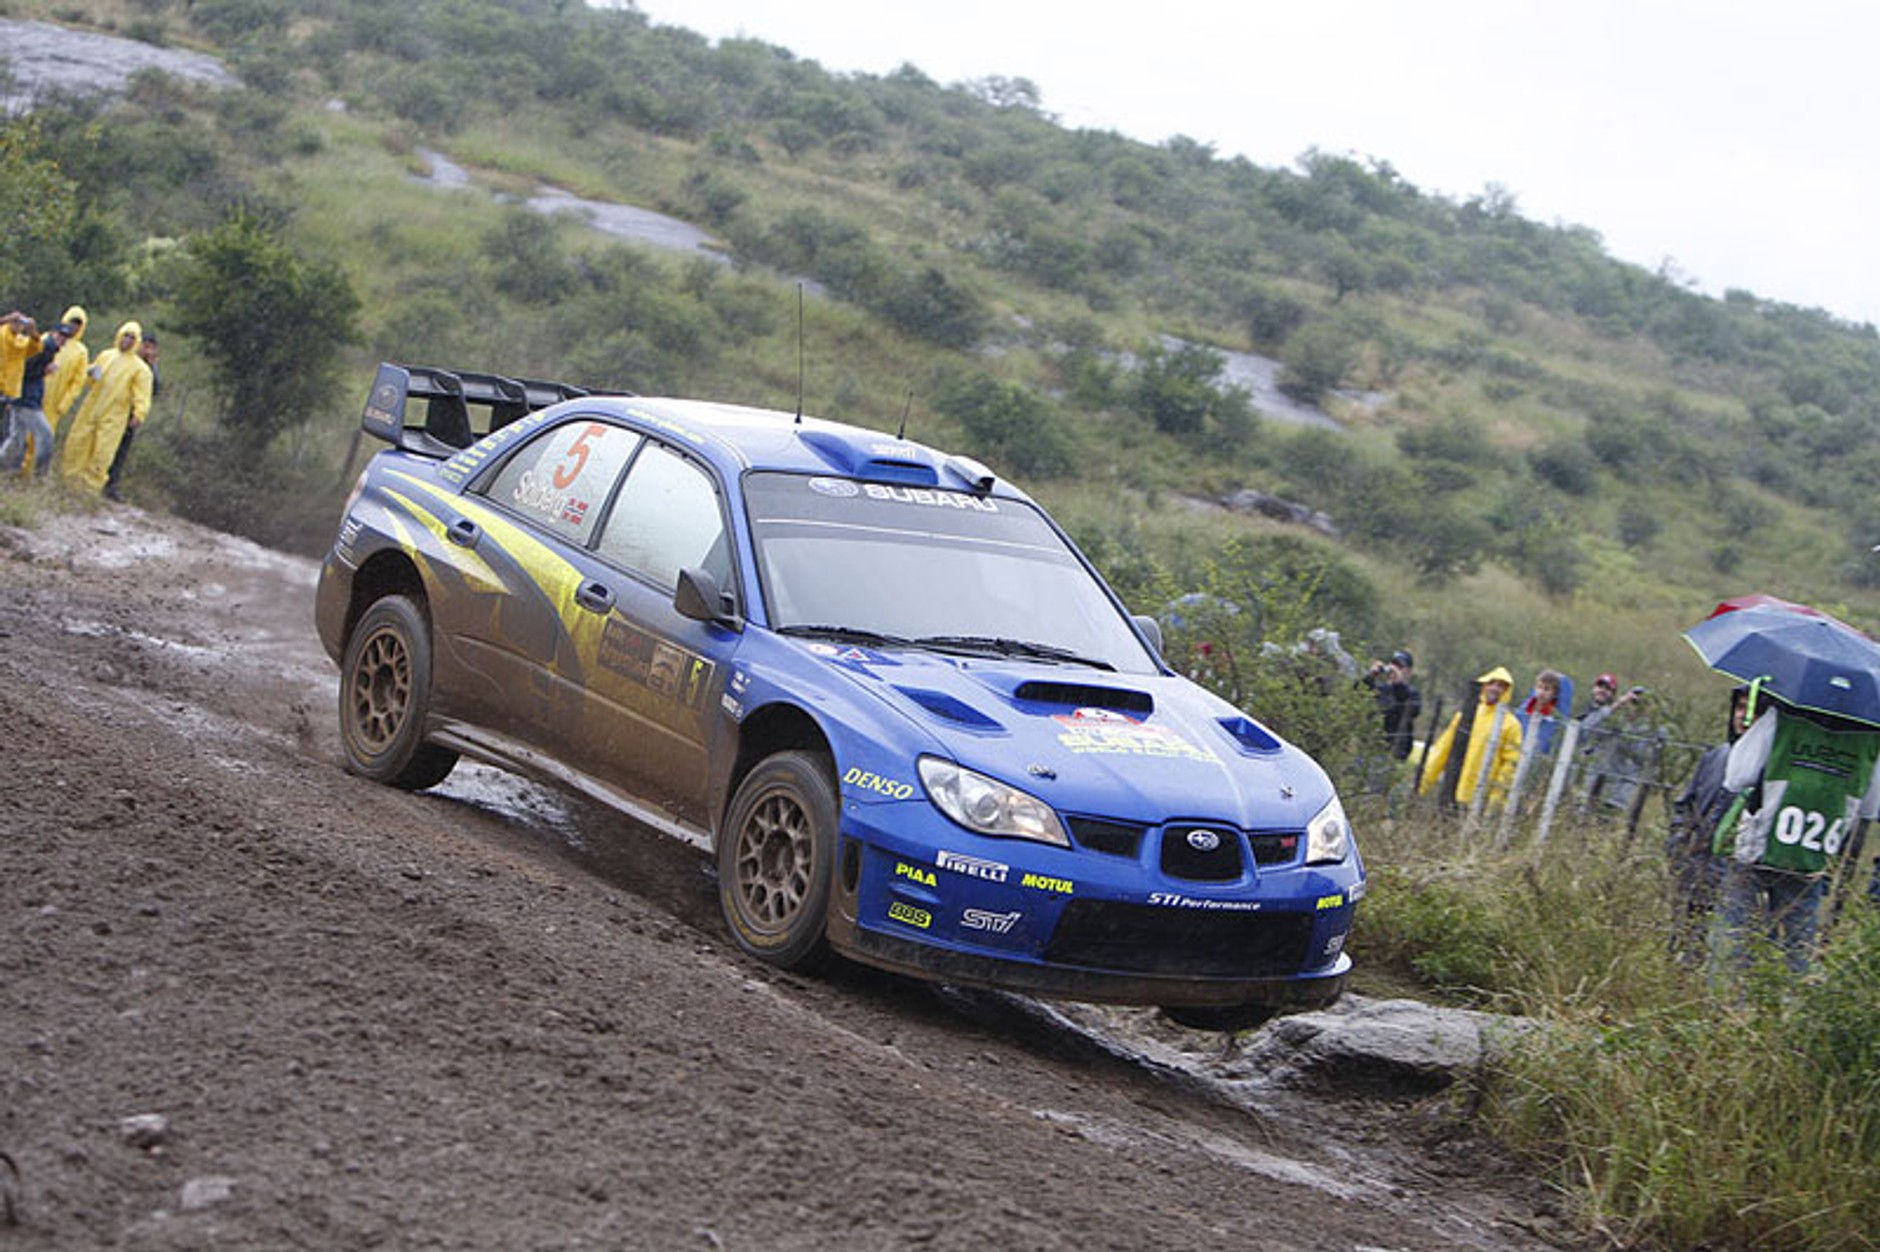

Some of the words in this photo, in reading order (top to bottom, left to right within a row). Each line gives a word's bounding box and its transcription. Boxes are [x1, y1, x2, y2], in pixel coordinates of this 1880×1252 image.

[552, 422, 608, 490] 5
[866, 484, 998, 512] SUBARU
[843, 767, 914, 800] DENSO
[1775, 806, 1846, 855] 026
[895, 862, 938, 888] PIAA
[935, 850, 1010, 883] PIRELLI
[1021, 873, 1074, 895] MOTUL
[1147, 892, 1179, 906] STI
[1180, 897, 1262, 911] Performance
